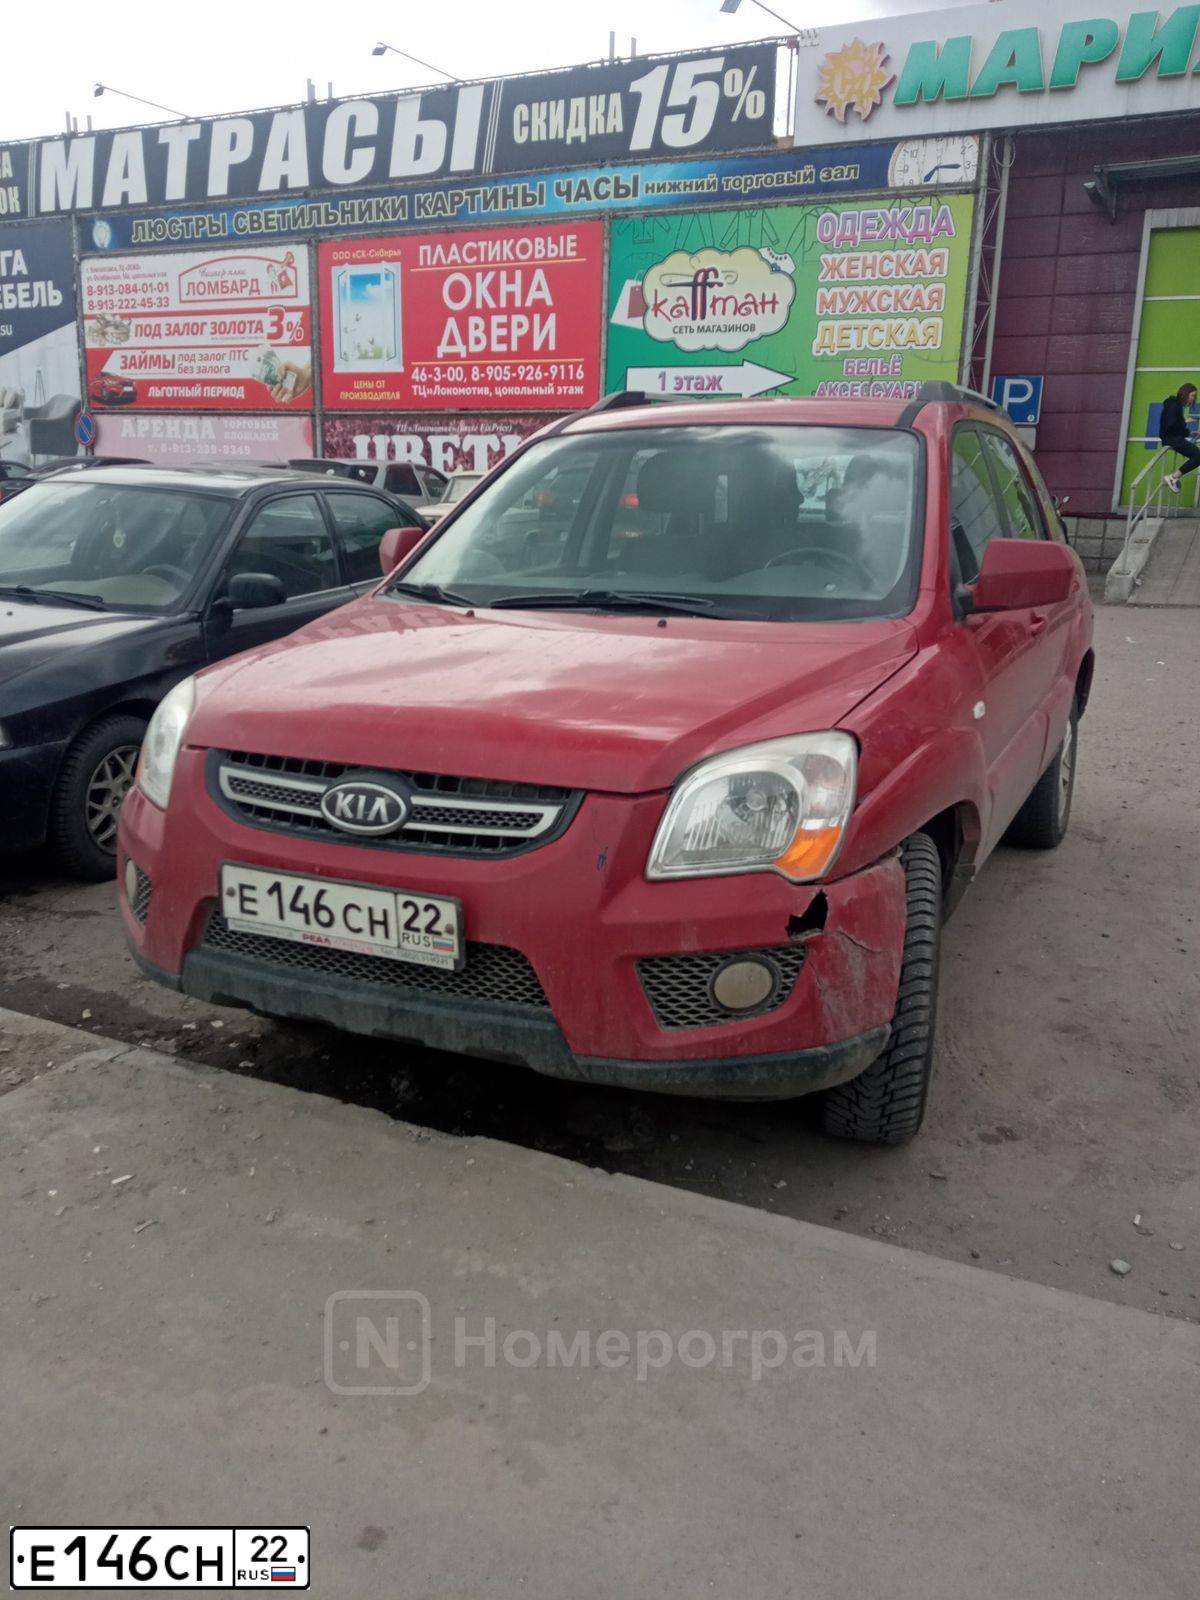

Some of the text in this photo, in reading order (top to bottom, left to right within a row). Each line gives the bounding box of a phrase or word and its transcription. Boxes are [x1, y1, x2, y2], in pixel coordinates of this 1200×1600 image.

[893, 4, 1200, 105] МАРИ
[513, 57, 766, 151] СКИДКА 15%
[40, 85, 485, 212] МАТРАСЫ
[132, 164, 860, 243] ЛЮСТРЫ СВЕТИЛЬНИКИ КАРТИНЫ ЧАСЫ нижний торговый зал
[818, 205, 955, 247] ОДЕЖДА
[332, 250, 351, 260] ООО
[418, 235, 577, 266] ПЛАСТИКОВЫЕ
[820, 251, 948, 280] ЖЕНСКАЯ
[0, 280, 63, 309] БЕЛЬ
[87, 282, 169, 296] 8-913-084-01-01
[186, 278, 261, 296] ЛОМБАРД
[442, 268, 553, 311] ОКНА
[88, 297, 170, 311] 8-913-222-45-33
[818, 285, 944, 314] МУЖСКАЯ
[134, 322, 162, 338] ПОД
[164, 321, 208, 337] ЗАЛОГ
[210, 319, 264, 335] ЗОЛОТА
[437, 313, 557, 358] ДВЕРИ
[673, 323, 756, 334] СЕТЬ МАГАЗИНОВ
[815, 321, 941, 352] ДЕТСКАЯ
[120, 351, 176, 371] ЗАЙМЫ
[178, 349, 249, 363] под залог ПТС
[844, 354, 902, 375] БЕЛЬЁ
[177, 363, 231, 375] без залога
[411, 364, 584, 383] 46-3-00, 8-905-926-9116
[148, 384, 245, 399] ЛЬГОТНЫЙ ПЕРИОД
[354, 380, 385, 390] ЦЕНЫ ОТ
[494, 382, 554, 396] цокольный
[556, 384, 584, 396] этаж
[658, 372, 723, 391] 1 этаж
[816, 381, 922, 398] АКСЕССУАР
[340, 391, 400, 400] ПРОИЗВОДИТЕЛЯ
[120, 418, 216, 441] АРЕНДА
[353, 434, 521, 475] ЦВЕТ
[334, 791, 389, 823] KIA
[238, 881, 443, 940] Е146СН 22
[402, 932, 432, 948] RUS
